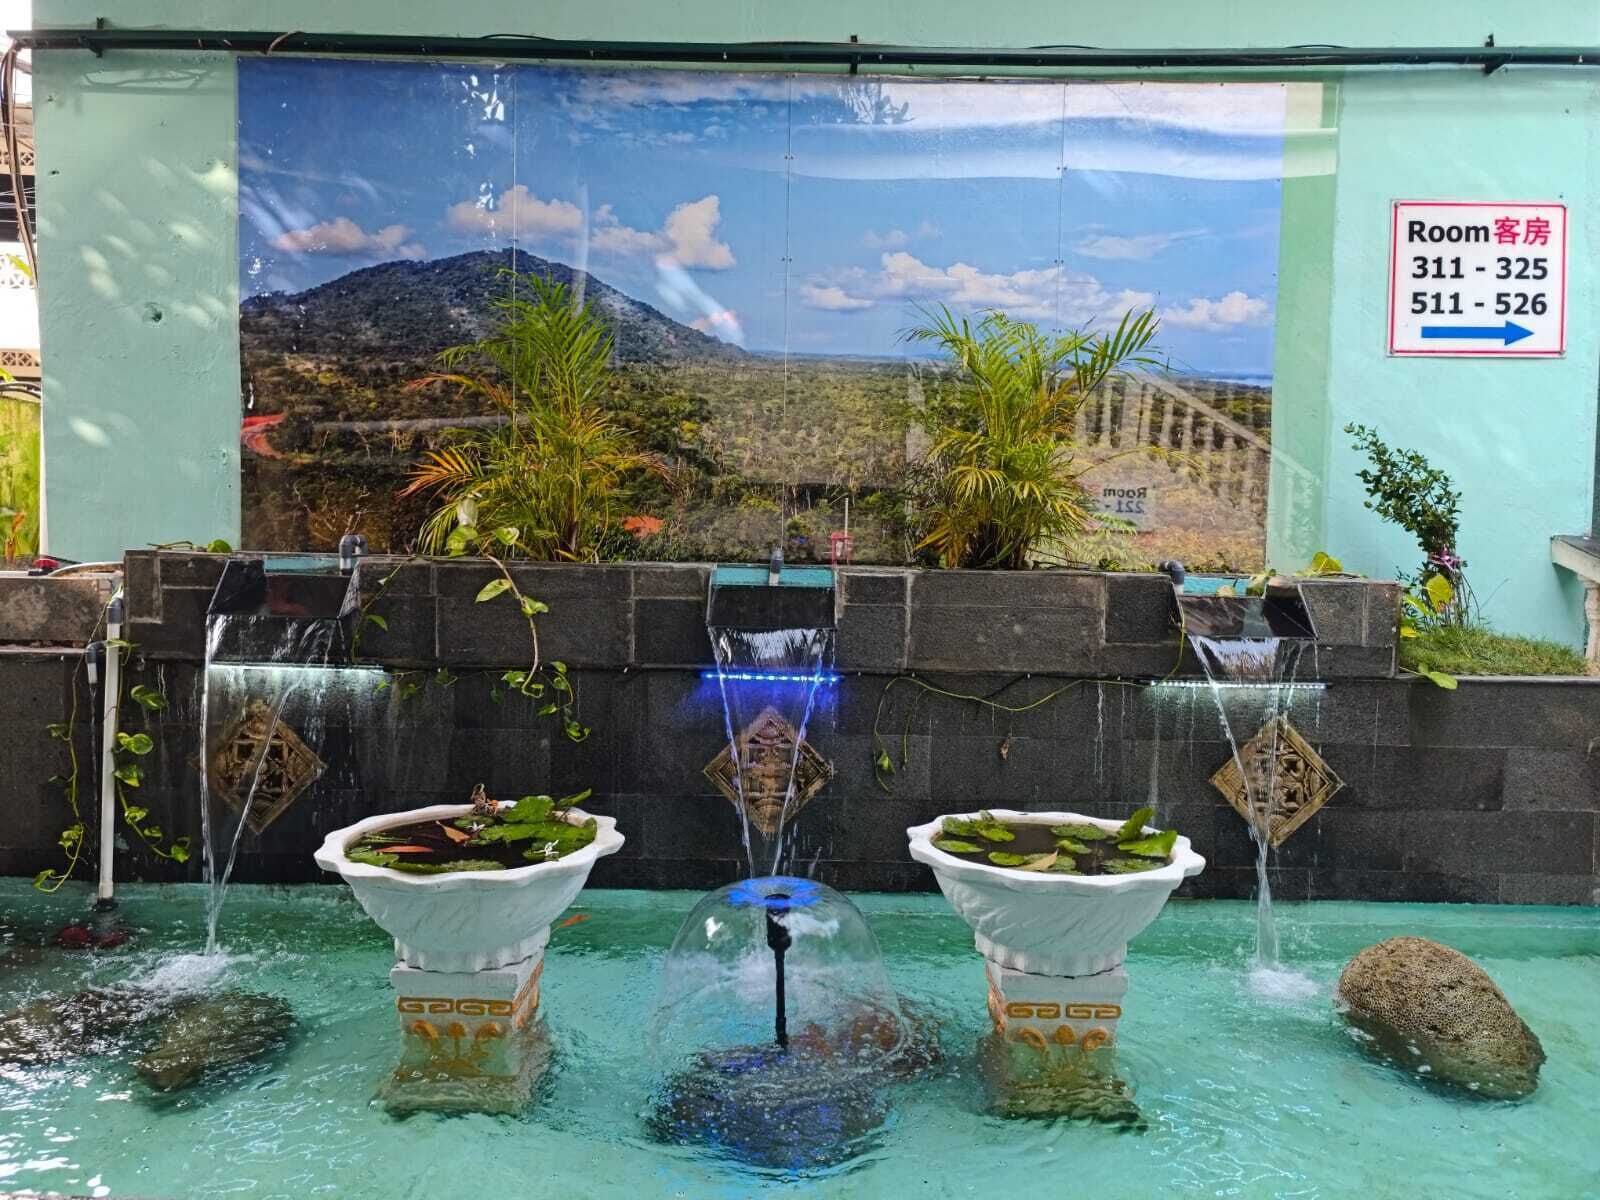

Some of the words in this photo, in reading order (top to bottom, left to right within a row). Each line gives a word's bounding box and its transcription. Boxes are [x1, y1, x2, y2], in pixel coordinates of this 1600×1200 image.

[1408, 221, 1489, 243] Room
[1494, 216, 1552, 246] 客房
[1411, 256, 1465, 279] 311
[1495, 257, 1548, 280] 325
[1411, 292, 1463, 315] 511
[1495, 293, 1548, 315] 526
